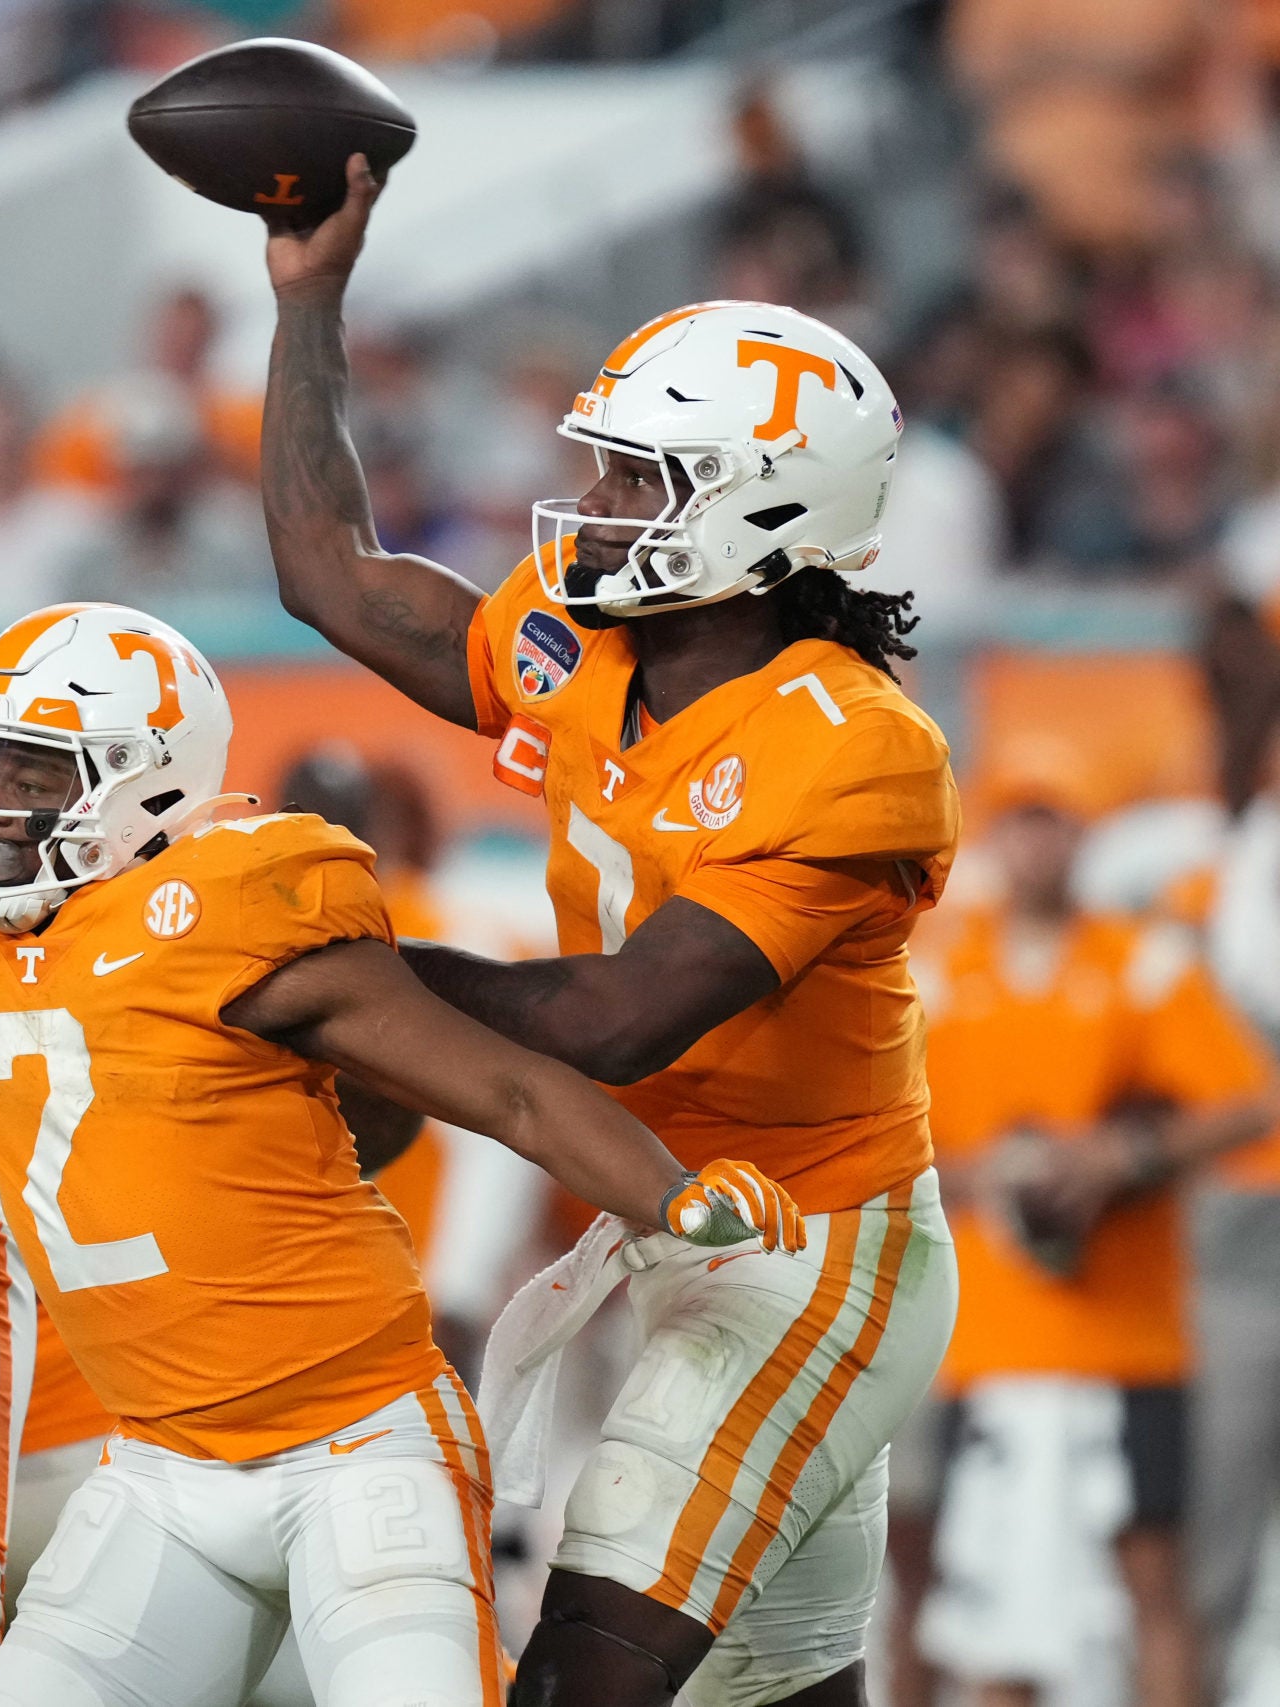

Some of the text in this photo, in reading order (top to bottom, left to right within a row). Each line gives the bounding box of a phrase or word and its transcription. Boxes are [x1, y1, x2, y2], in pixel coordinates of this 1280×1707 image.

[573, 395, 597, 417] OLS
[737, 339, 835, 448] T
[108, 632, 200, 732] T
[518, 638, 564, 686] ORANGE BOWL
[776, 672, 847, 726] 7
[497, 727, 548, 782] C
[602, 758, 626, 803] T
[705, 757, 742, 810] SEC
[690, 794, 732, 828] GRADUATE
[567, 800, 635, 956] 7
[146, 882, 196, 936] SEC
[16, 946, 46, 985] T
[365, 1474, 426, 1553] 2
